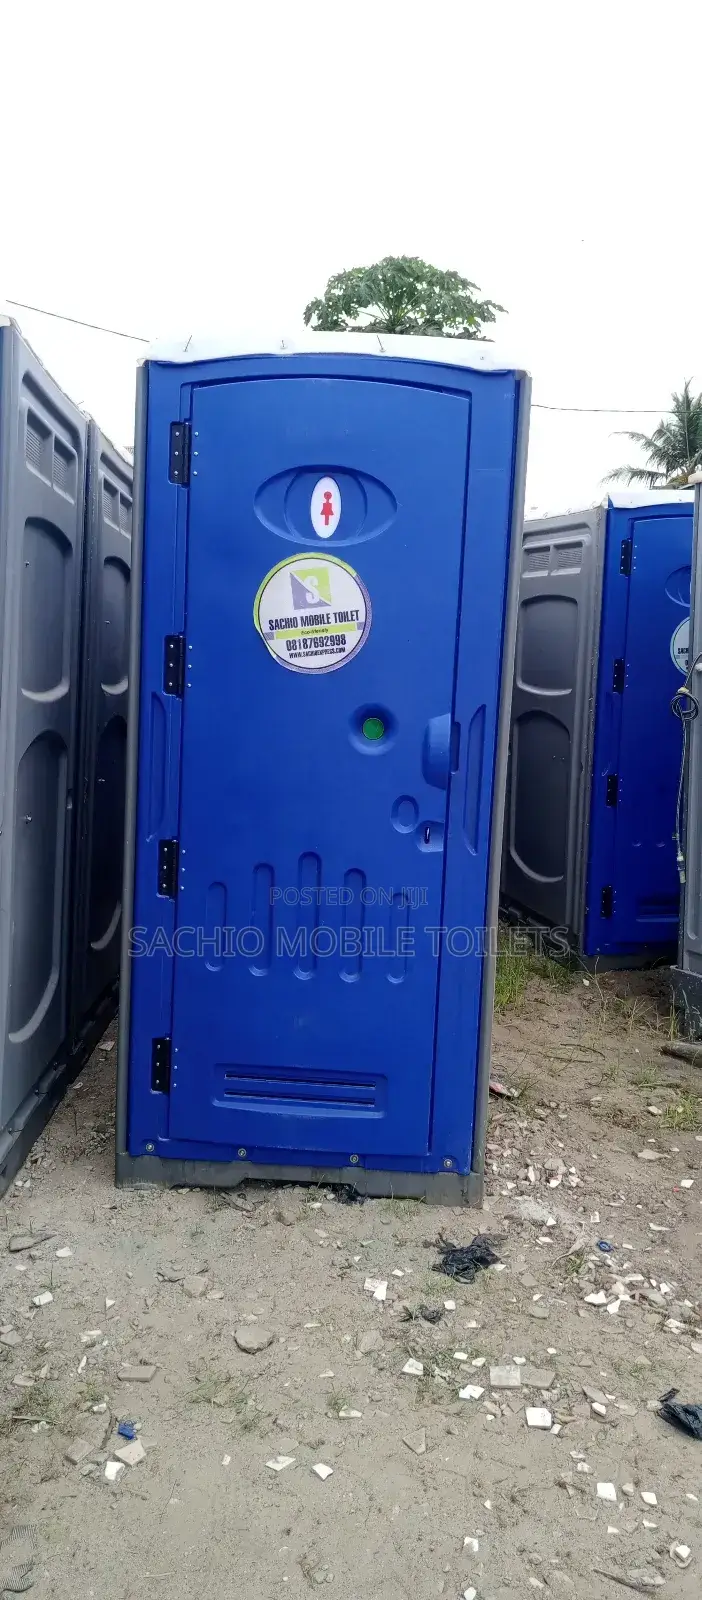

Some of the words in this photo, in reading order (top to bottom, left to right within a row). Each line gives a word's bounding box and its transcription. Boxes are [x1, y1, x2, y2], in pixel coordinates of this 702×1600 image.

[304, 575, 320, 604] S
[268, 617, 298, 630] SACHIO
[300, 613, 331, 627] MOBILE
[333, 609, 360, 623] TOILET
[285, 634, 346, 651] 08187692998
